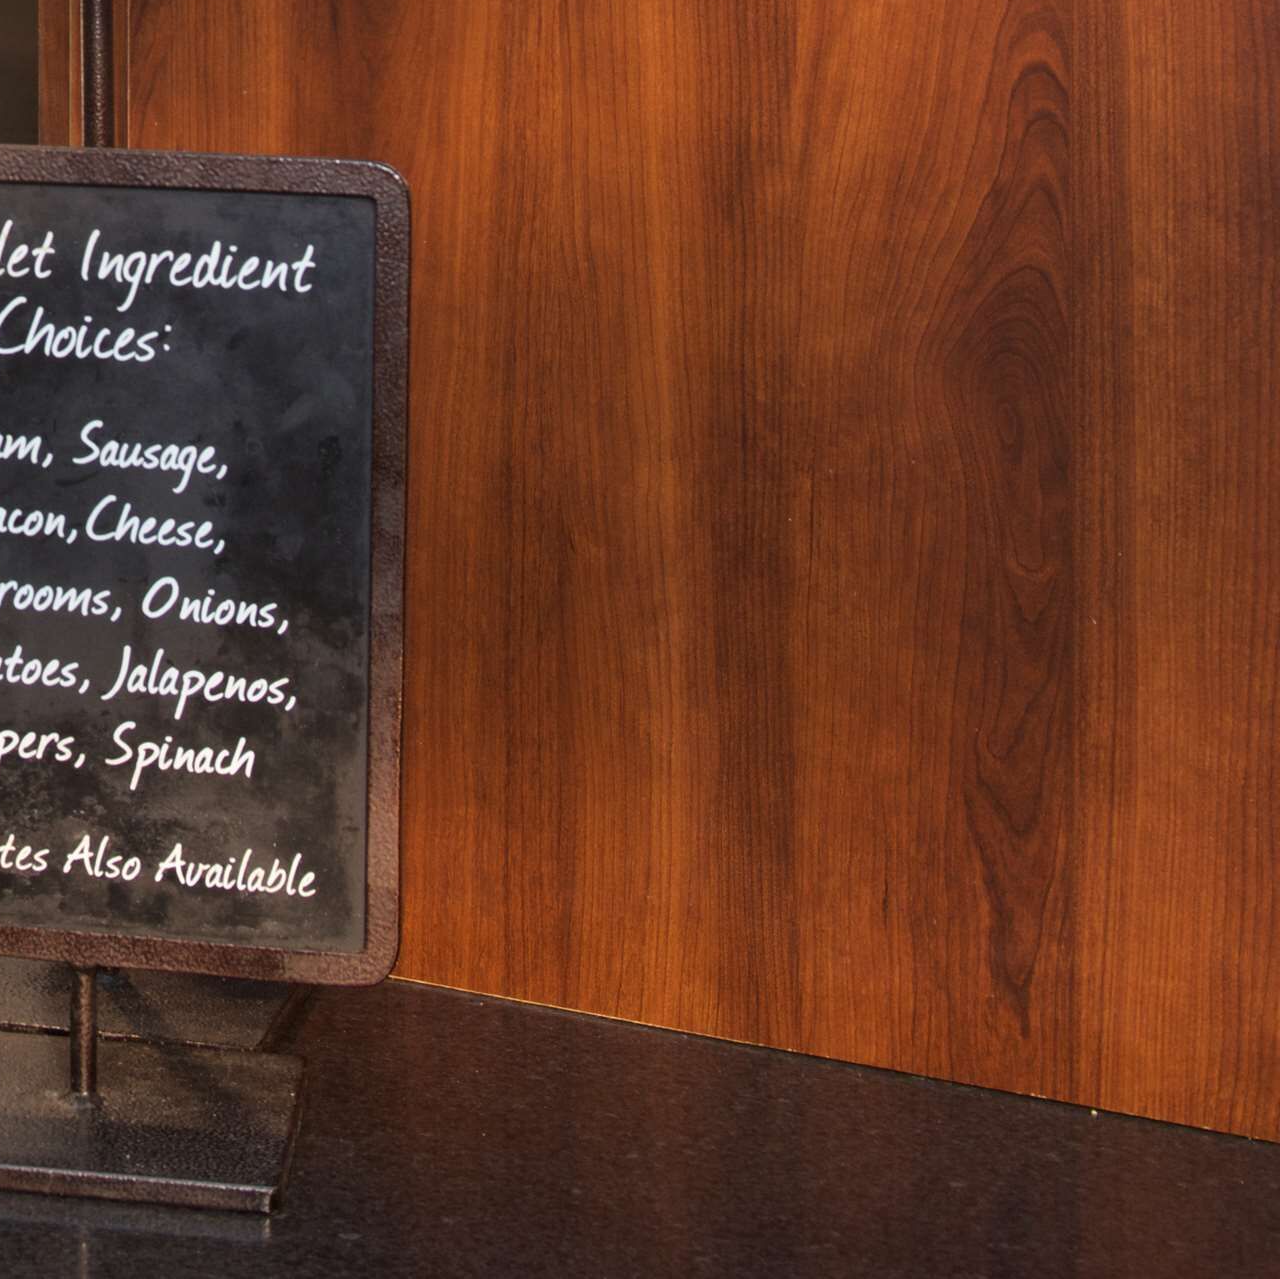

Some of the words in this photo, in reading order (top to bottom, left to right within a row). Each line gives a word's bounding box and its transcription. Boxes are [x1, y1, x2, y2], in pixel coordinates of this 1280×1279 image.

[81, 229, 316, 312] Ingredient
[72, 419, 228, 494] Sausage,
[85, 494, 225, 555] Cheese,
[142, 576, 289, 635] Onions,
[101, 645, 296, 720] Jalapenos,
[105, 721, 255, 791] Spinach
[63, 834, 141, 881] Also
[154, 842, 316, 897] Available
